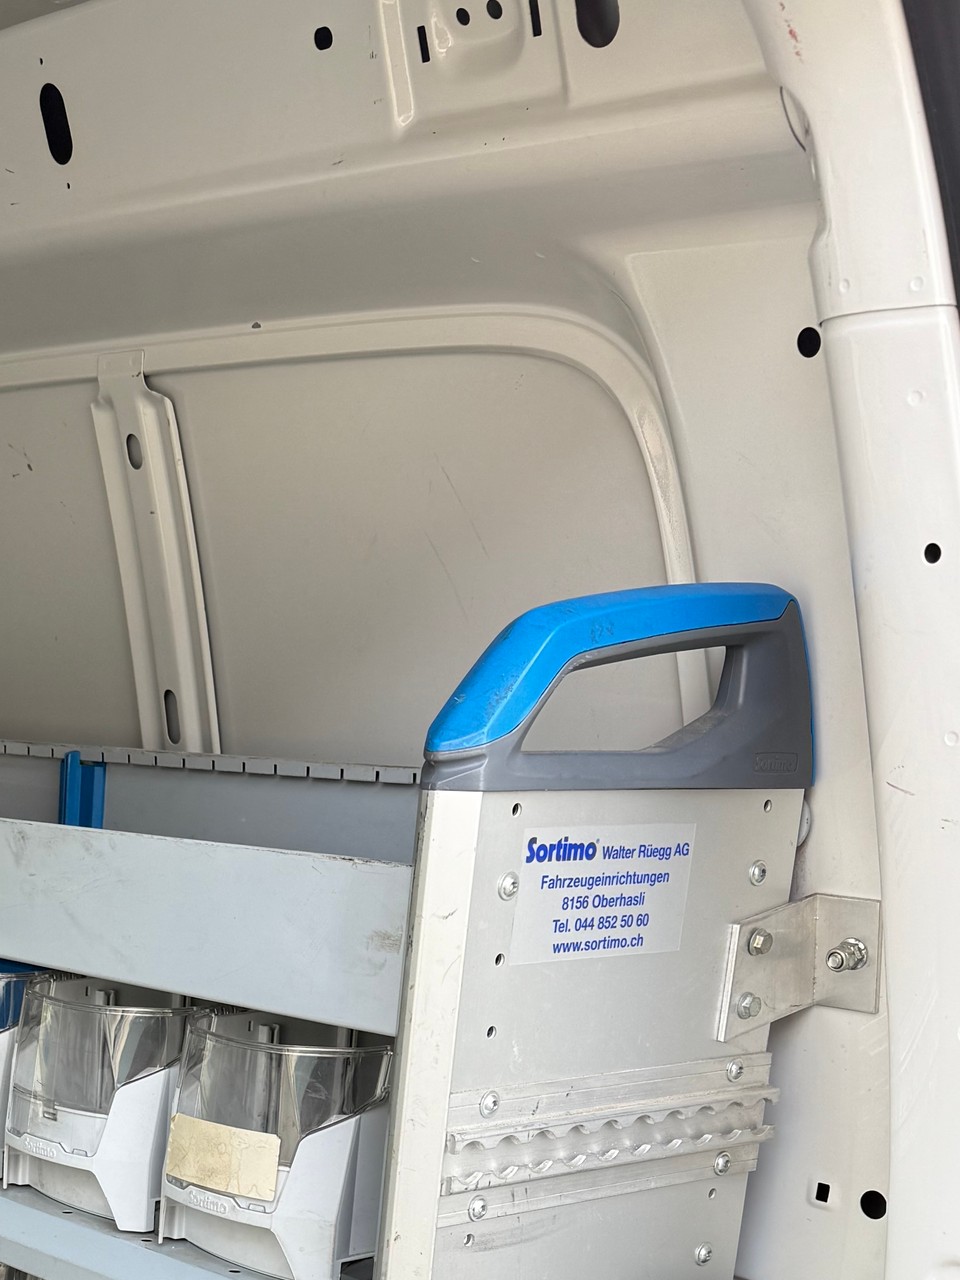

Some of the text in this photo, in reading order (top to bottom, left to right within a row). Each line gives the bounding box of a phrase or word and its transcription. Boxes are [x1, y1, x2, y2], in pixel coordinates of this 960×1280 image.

[526, 836, 690, 863] Sortimo Walter Rüegg AG
[540, 871, 670, 890] Fahrzeugeinrichtungen
[562, 892, 646, 910] 8156 Oberhasli
[553, 913, 649, 933] Tel. 044 852 50 60
[552, 933, 644, 954] www.sortimo.ch
[23, 1137, 57, 1159] Sortimo
[188, 1190, 228, 1215] Sortimo
